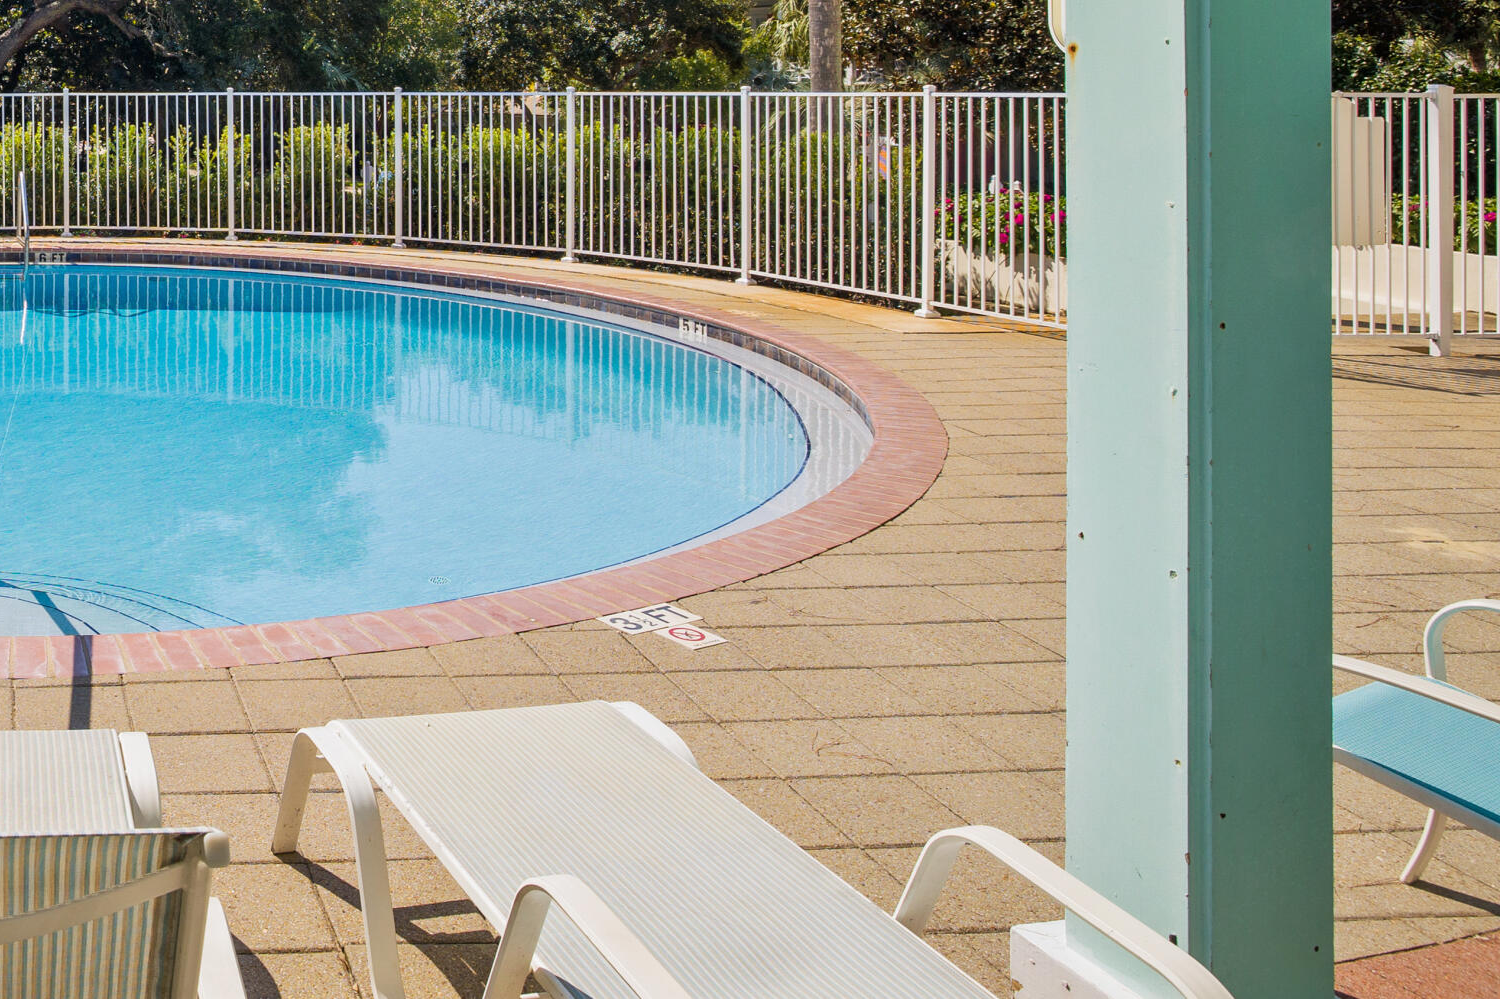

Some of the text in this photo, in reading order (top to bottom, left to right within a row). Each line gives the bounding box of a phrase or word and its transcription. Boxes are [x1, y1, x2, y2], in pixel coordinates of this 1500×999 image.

[39, 253, 66, 263] 6 FT
[682, 318, 706, 336] 5 FT
[641, 605, 689, 624] FT
